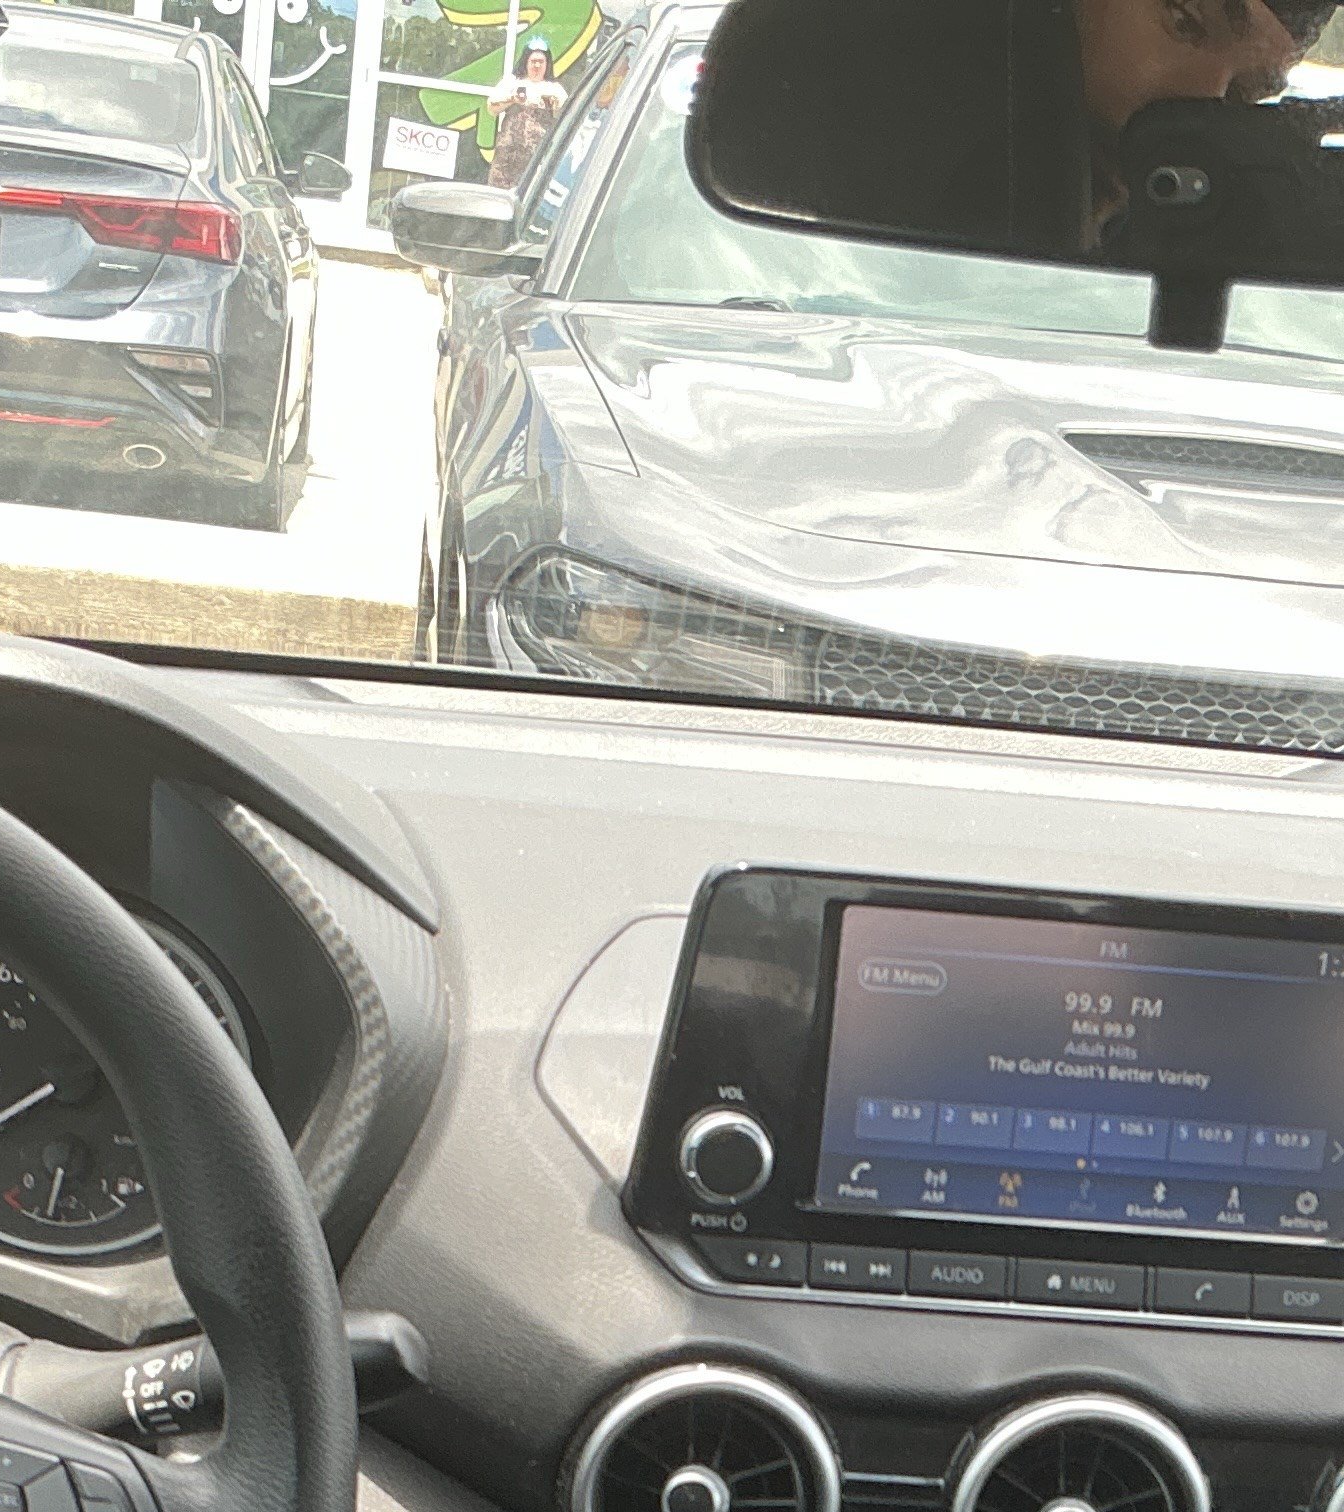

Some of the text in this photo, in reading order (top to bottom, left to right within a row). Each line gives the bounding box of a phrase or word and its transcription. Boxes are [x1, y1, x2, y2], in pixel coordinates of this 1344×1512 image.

[396, 126, 450, 152] SKCO
[1099, 939, 1129, 960] FM
[862, 966, 941, 988] FM Menu
[1064, 990, 1164, 1018] 99.9 FM
[1071, 1018, 1137, 1040] Mix 99.9
[1064, 1039, 1138, 1062] Adult Hits
[988, 1054, 1211, 1090] The Gulf Coast's Better Variety
[718, 1084, 745, 1102] VOL
[837, 1183, 879, 1201] Phone
[922, 1190, 946, 1205] AM
[690, 1212, 728, 1230] PUSH
[1125, 1203, 1188, 1221] Bluetooth
[1216, 1210, 1246, 1226] AUX
[1278, 1214, 1329, 1234] Settings
[930, 1265, 985, 1285] AUDIO
[1069, 1275, 1116, 1295] MENU
[1282, 1288, 1322, 1308] DISP
[140, 1380, 164, 1399] OFF
